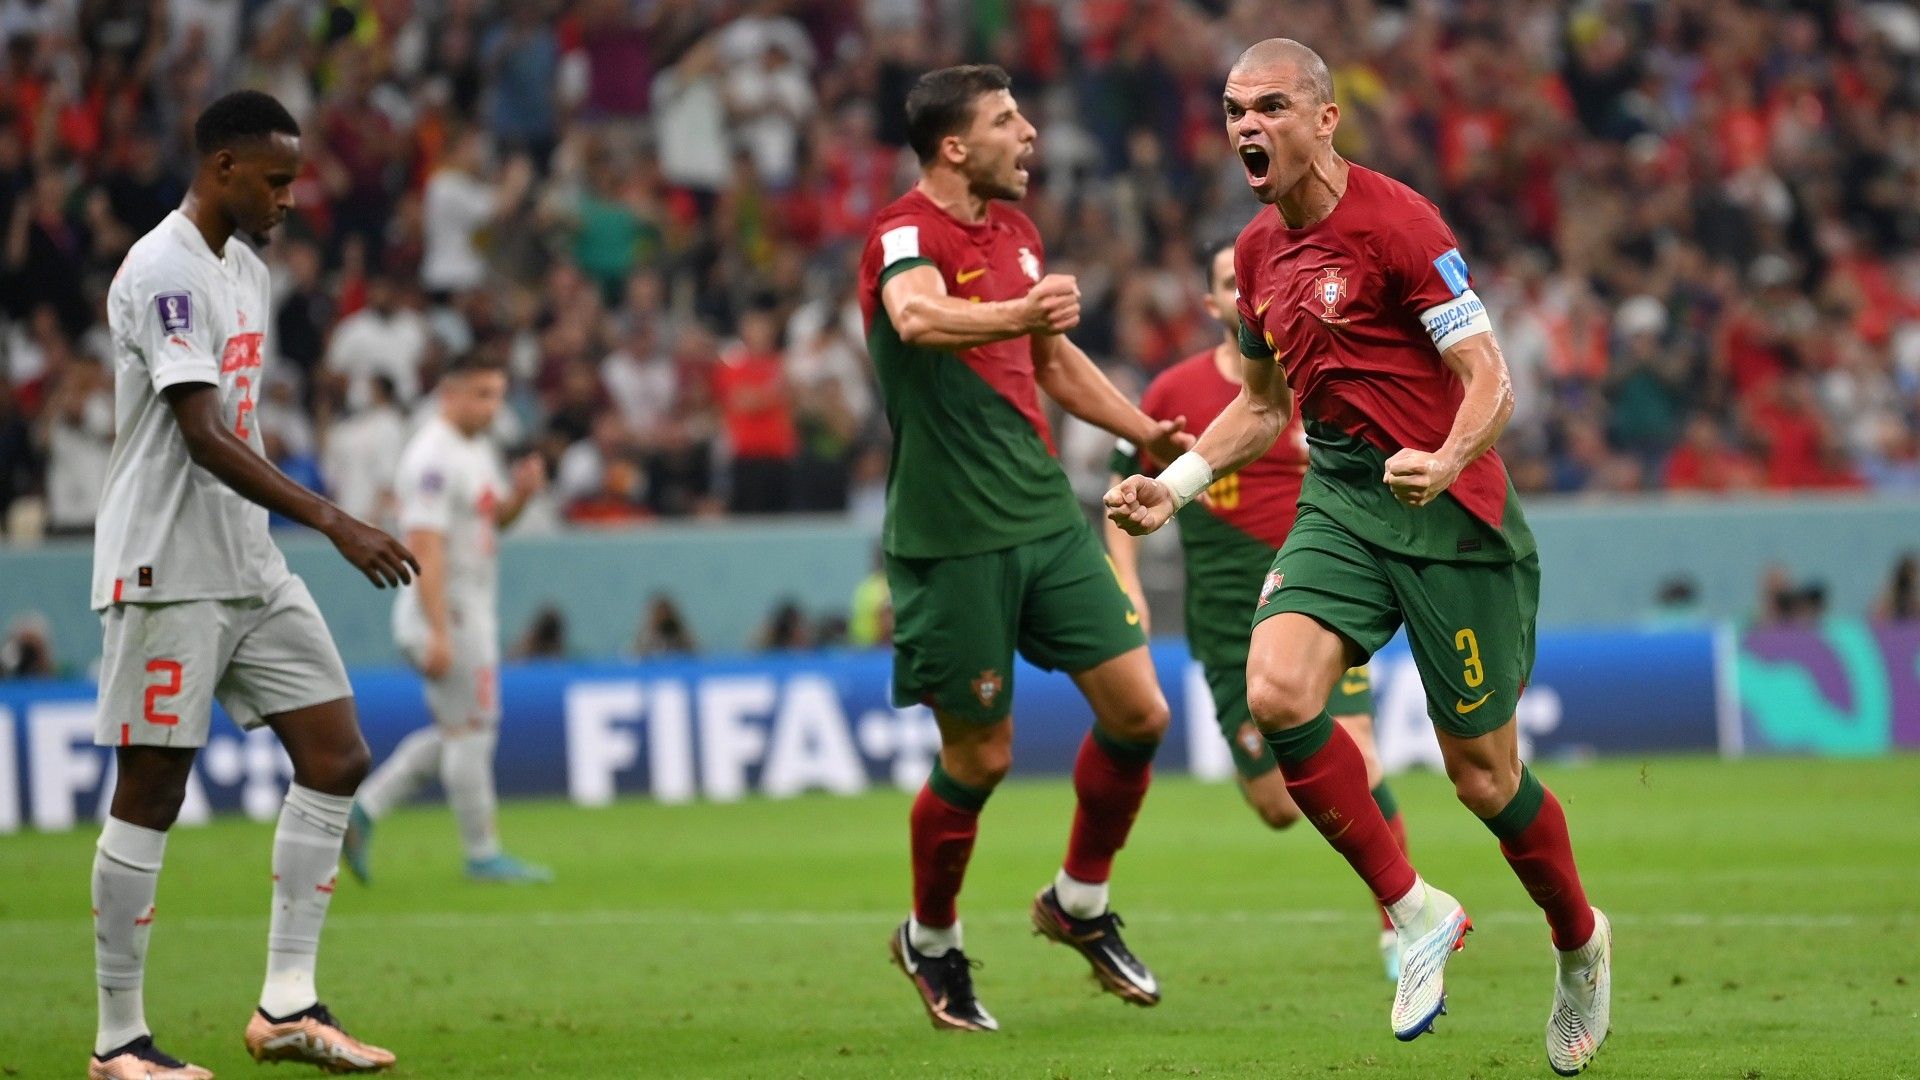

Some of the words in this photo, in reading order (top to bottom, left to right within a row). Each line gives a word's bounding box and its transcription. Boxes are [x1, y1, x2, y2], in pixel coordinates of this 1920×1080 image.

[1452, 315, 1472, 331] ALL
[235, 375, 254, 439] 2
[1455, 628, 1484, 688] 3
[144, 659, 182, 725] 2
